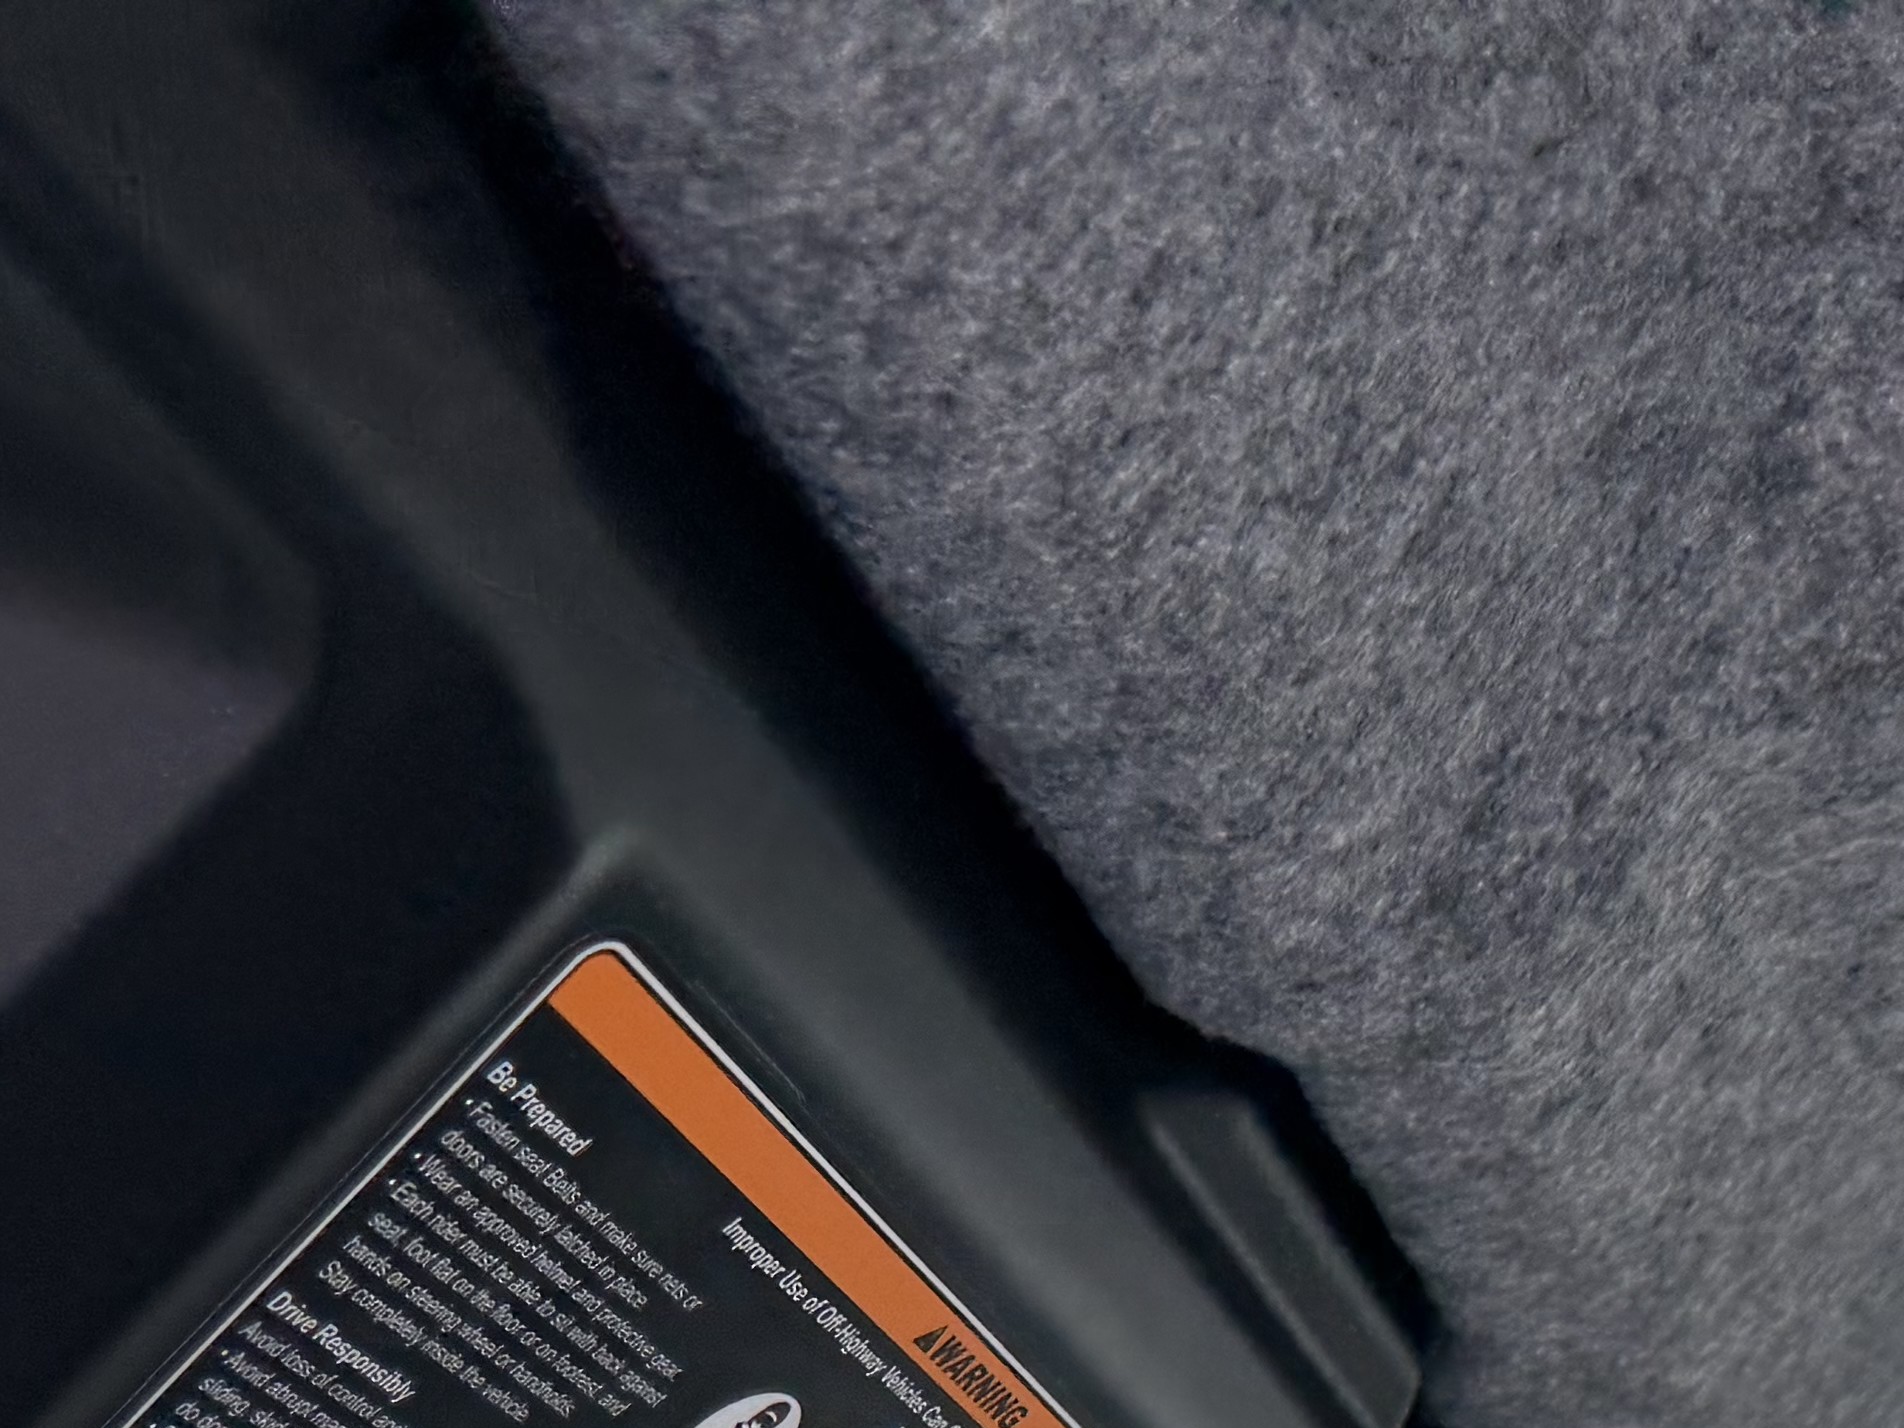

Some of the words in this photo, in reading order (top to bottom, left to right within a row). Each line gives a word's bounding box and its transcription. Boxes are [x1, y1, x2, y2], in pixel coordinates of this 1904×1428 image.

[486, 1059, 520, 1094] Be
[508, 1082, 594, 1159] Prepared
[416, 1154, 464, 1195] Wear
[453, 1188, 480, 1212] an
[470, 1203, 543, 1261] approved
[570, 1285, 606, 1313] and
[439, 1128, 487, 1170] doors
[477, 1163, 509, 1190] are
[499, 1181, 563, 1237] securely
[467, 1100, 522, 1152] Fasten
[573, 1198, 611, 1228] and
[598, 1219, 640, 1255] make
[630, 1248, 664, 1279] sure
[389, 1180, 436, 1222] Each
[427, 1211, 469, 1246] rider
[457, 1237, 501, 1273] must
[489, 1260, 516, 1285] be
[506, 1276, 543, 1307] able
[534, 1297, 558, 1319] to
[719, 1215, 788, 1280] Improper
[777, 1268, 811, 1302] Use
[266, 1289, 320, 1334] Drive
[309, 1322, 418, 1405] Responsibly
[316, 1259, 359, 1297] Stay
[348, 1286, 430, 1349] completely
[419, 1337, 467, 1374] inside
[458, 1364, 487, 1389] the
[342, 1233, 394, 1278] hands
[385, 1270, 412, 1292] on
[403, 1283, 464, 1334] steering
[493, 1352, 517, 1371] or
[450, 1277, 476, 1299] on
[468, 1287, 497, 1314] the
[518, 1330, 542, 1348] or
[534, 1342, 558, 1363] on
[596, 1391, 632, 1417] and
[801, 1295, 830, 1316] of
[814, 1305, 890, 1378] Off-Highway
[173, 1400, 202, 1423] do
[222, 1350, 276, 1388] Avoid
[263, 1379, 320, 1420] abrupt
[237, 1319, 292, 1358] Avoid
[279, 1347, 317, 1379] loss
[310, 1370, 339, 1390] of
[326, 1381, 383, 1421] control
[880, 1365, 930, 1414] Vehicles
